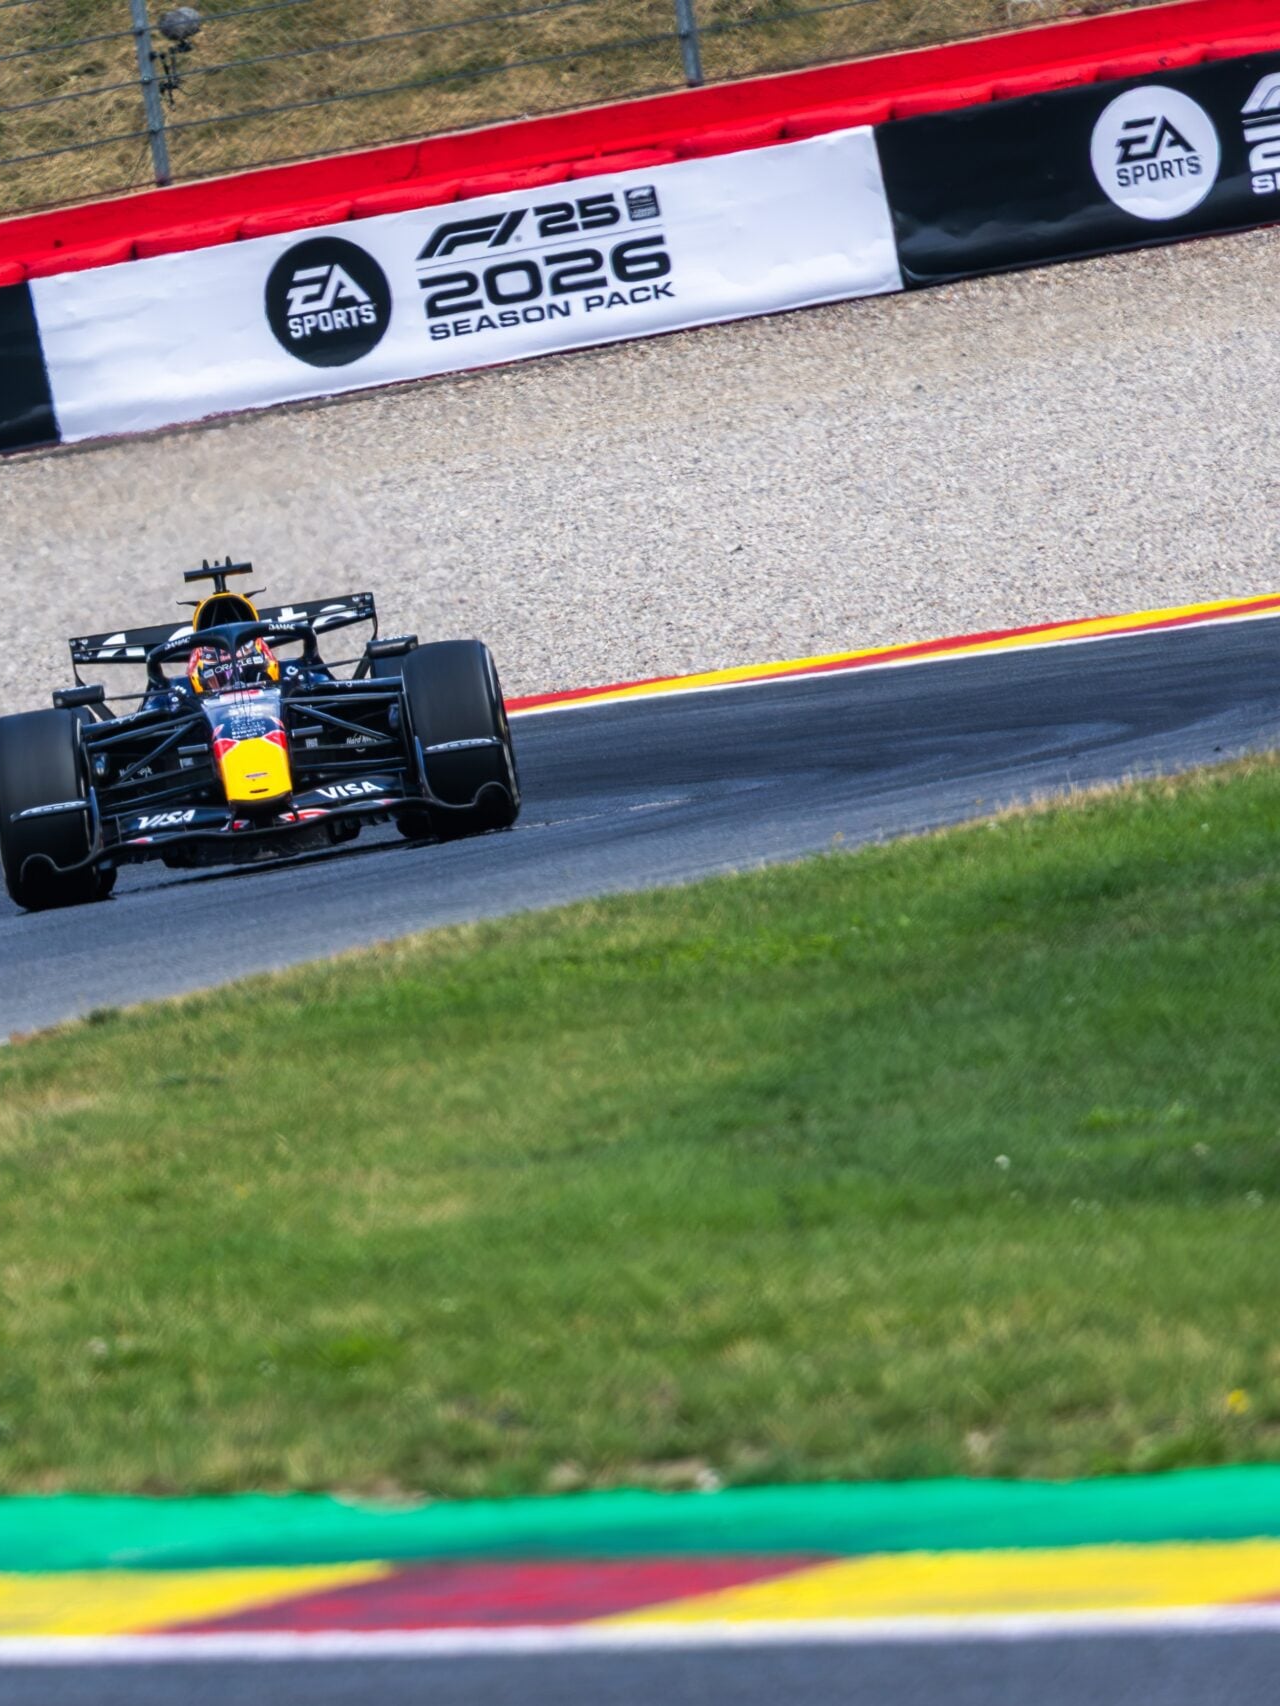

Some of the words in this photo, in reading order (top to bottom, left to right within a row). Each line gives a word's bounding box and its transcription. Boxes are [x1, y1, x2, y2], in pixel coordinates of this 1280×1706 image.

[1115, 115, 1197, 165] EA
[1116, 155, 1202, 187] SPORTS
[533, 192, 621, 238] 25
[286, 263, 371, 315] EA
[418, 234, 672, 319] 2026
[288, 304, 377, 340] SPORTS
[429, 300, 571, 341] SEASON
[584, 281, 676, 313] PACK
[316, 780, 384, 799] VISA
[138, 809, 196, 829] VISA
